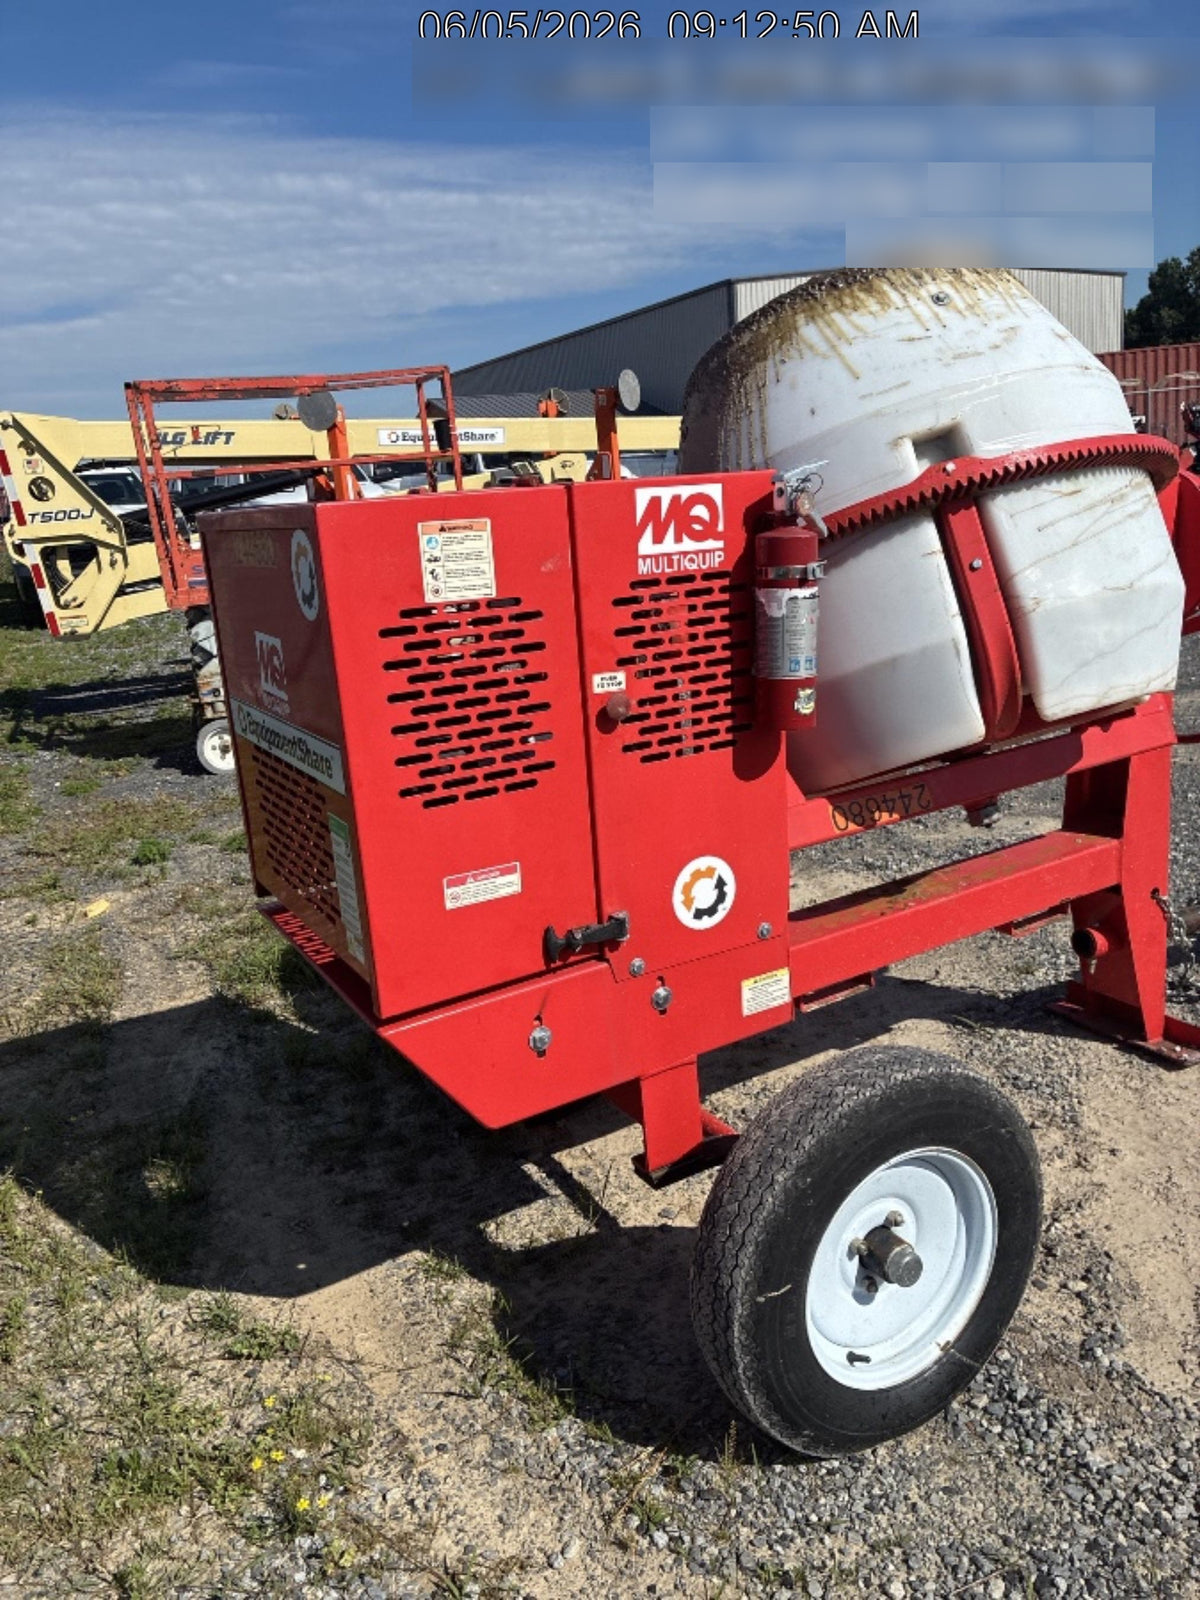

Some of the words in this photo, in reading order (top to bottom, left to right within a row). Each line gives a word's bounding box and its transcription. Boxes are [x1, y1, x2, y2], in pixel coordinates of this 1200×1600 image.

[401, 430, 497, 443] EqutShare
[28, 507, 94, 524] T500J
[635, 490, 722, 546] MQ
[637, 550, 724, 575] MULTIQUIP
[247, 711, 334, 779] EquipmentShare
[832, 783, 931, 831] 244680
